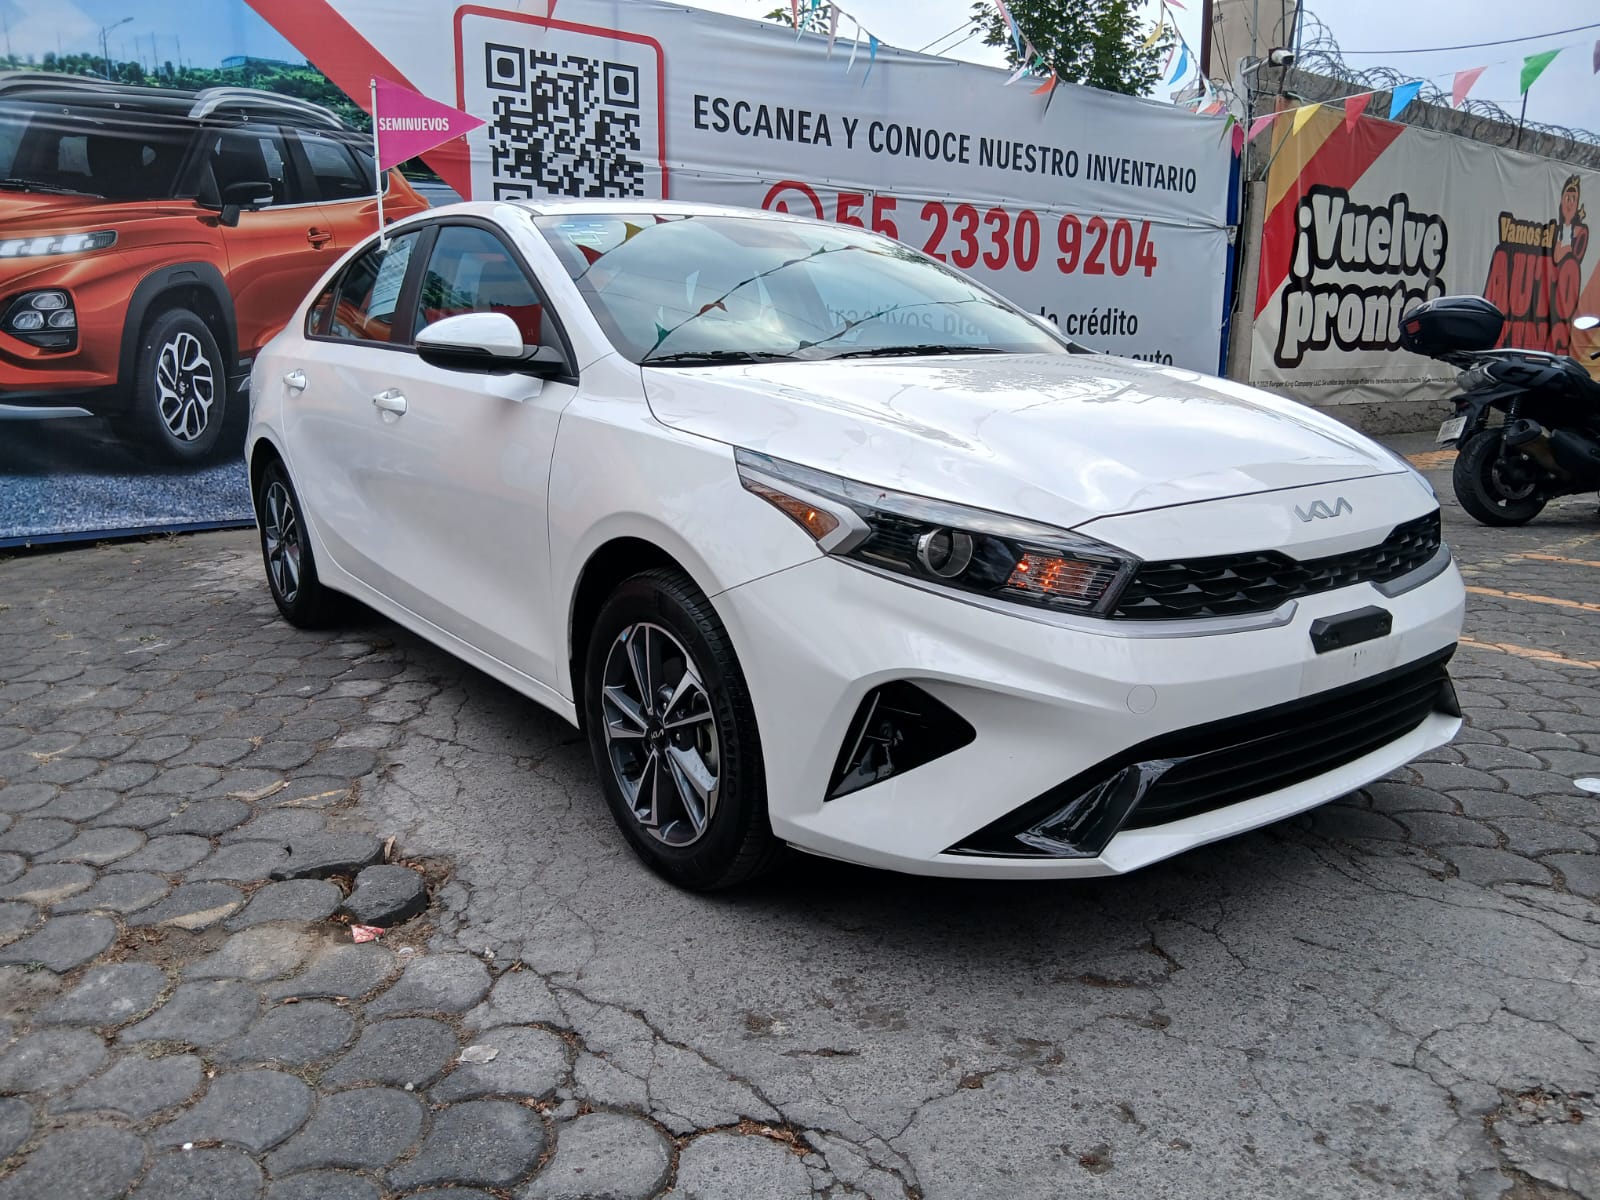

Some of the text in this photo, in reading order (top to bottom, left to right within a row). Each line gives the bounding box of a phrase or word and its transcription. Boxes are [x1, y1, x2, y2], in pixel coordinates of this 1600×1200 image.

[378, 117, 450, 132] SEMINUEVOS
[693, 94, 1197, 194] ESCANEA Y CONOCE NUESTRO INVENTARIO
[920, 201, 1041, 273] 2330
[1056, 213, 1158, 278] 9204
[1292, 193, 1444, 279] ¡Vuelve
[1500, 216, 1557, 249] Vamos al
[1484, 249, 1581, 320] AUTO
[1066, 307, 1139, 336] crédito
